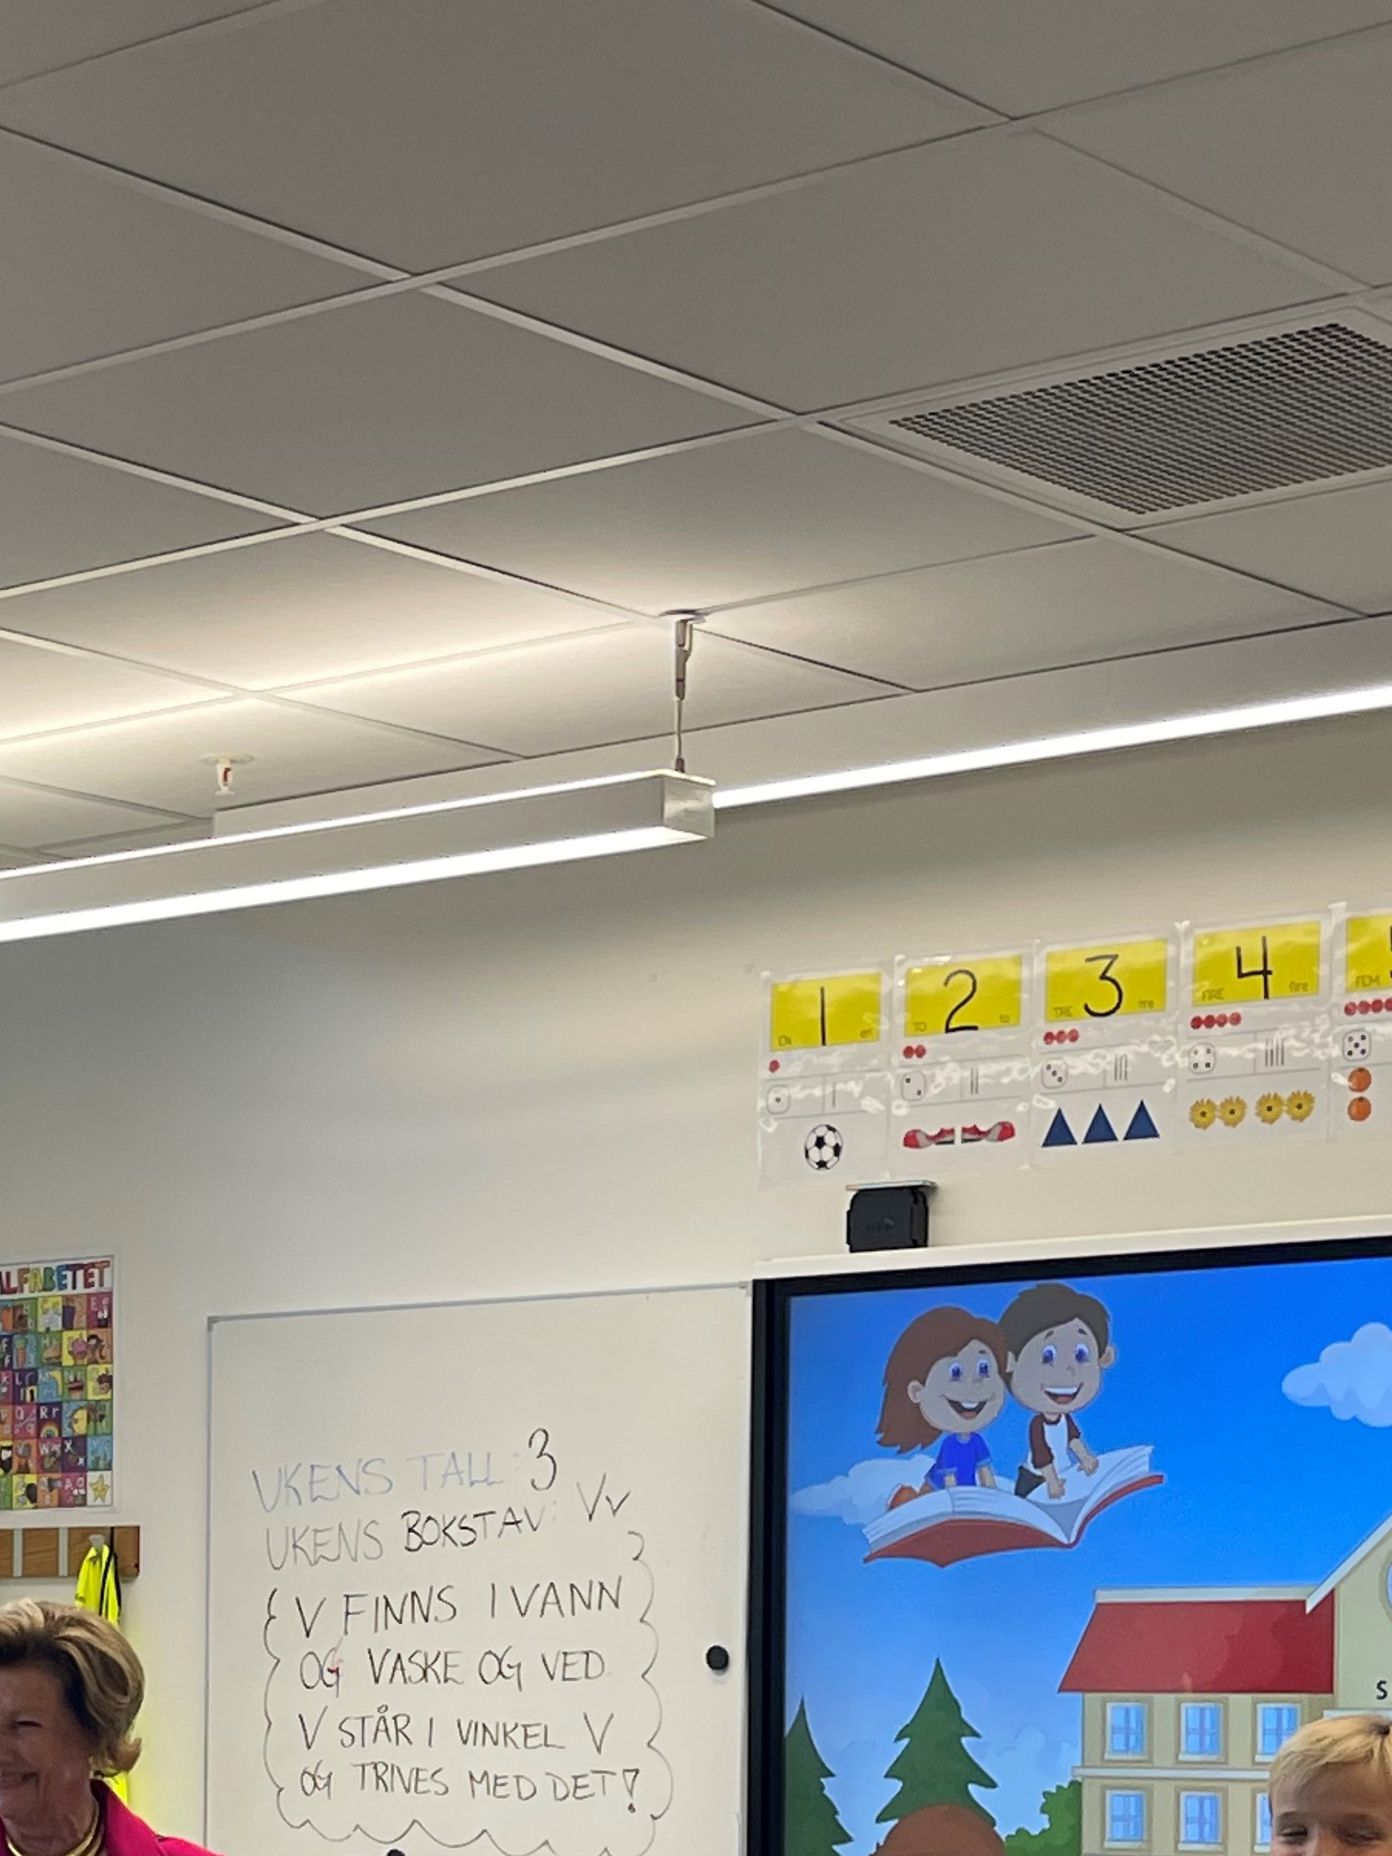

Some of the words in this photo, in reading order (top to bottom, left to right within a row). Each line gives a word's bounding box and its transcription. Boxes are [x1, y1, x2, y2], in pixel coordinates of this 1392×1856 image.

[1083, 953, 1123, 1018] 3
[1235, 935, 1273, 1000] 4
[943, 969, 979, 1034] 2
[251, 1456, 394, 1514] UKENS
[527, 1427, 558, 1492] 3
[265, 1517, 385, 1572] UKENS
[294, 1595, 328, 1640] V
[342, 1584, 458, 1637] FINNS
[510, 1574, 623, 1619] VANN
[299, 1646, 342, 1699] OG
[367, 1647, 465, 1686] VASKE
[478, 1644, 523, 1693] OG
[540, 1648, 606, 1683] VED
[297, 1704, 329, 1751] V
[337, 1703, 414, 1749] STÅR
[456, 1717, 566, 1750] VINKEL
[582, 1711, 615, 1756] V
[299, 1759, 334, 1801] OG
[349, 1760, 450, 1797] TRIVES
[467, 1769, 538, 1801] MED
